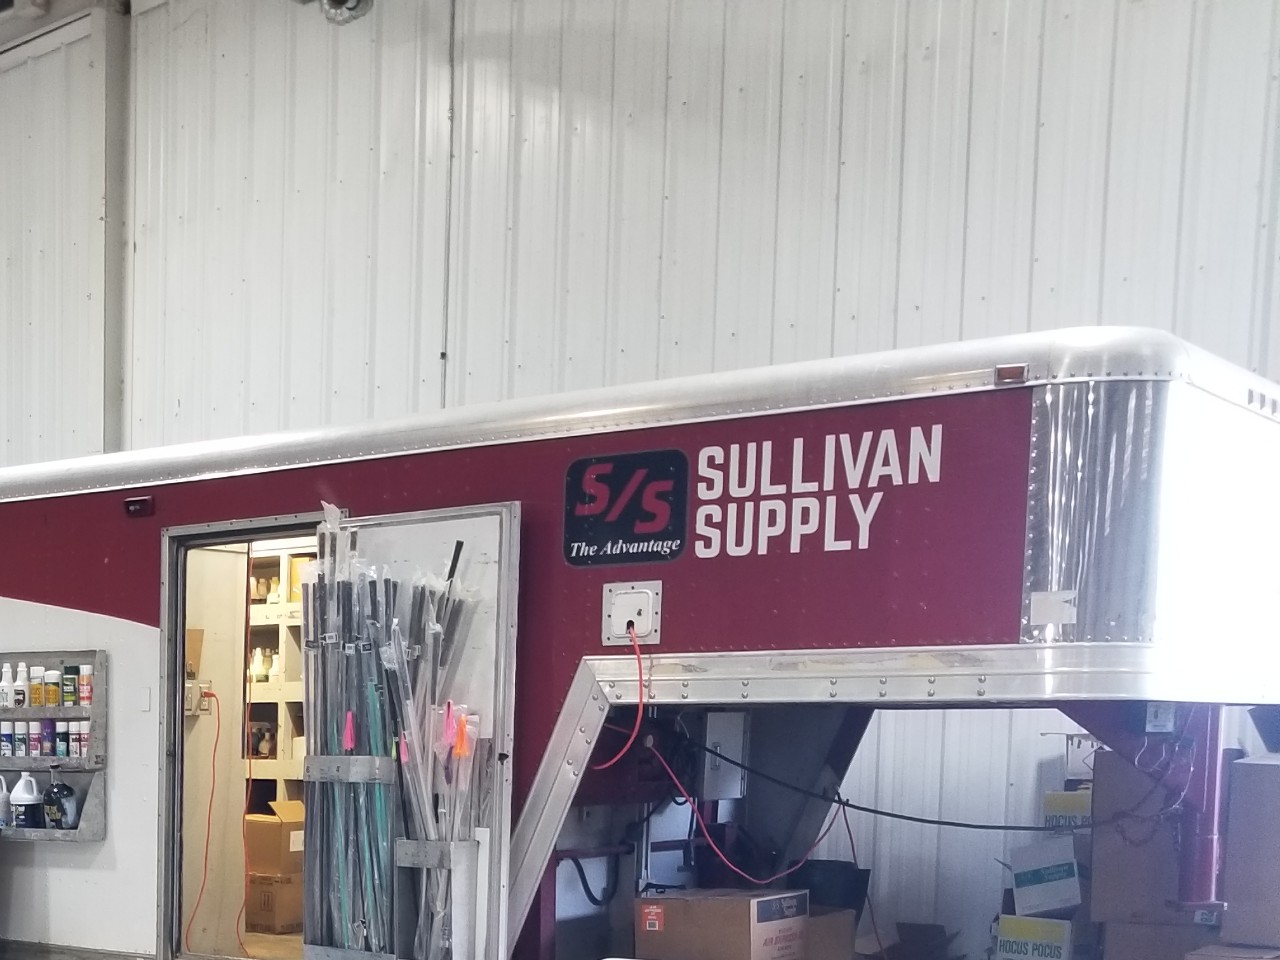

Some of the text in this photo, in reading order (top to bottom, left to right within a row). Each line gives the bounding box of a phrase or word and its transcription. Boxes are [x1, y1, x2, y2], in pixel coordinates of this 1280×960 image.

[697, 424, 942, 500] SULLIVAN
[575, 463, 675, 534] S/S
[695, 492, 884, 558] SUPPLY
[570, 537, 681, 557] The Advantage
[999, 939, 1062, 960] HOCUS POCUS
